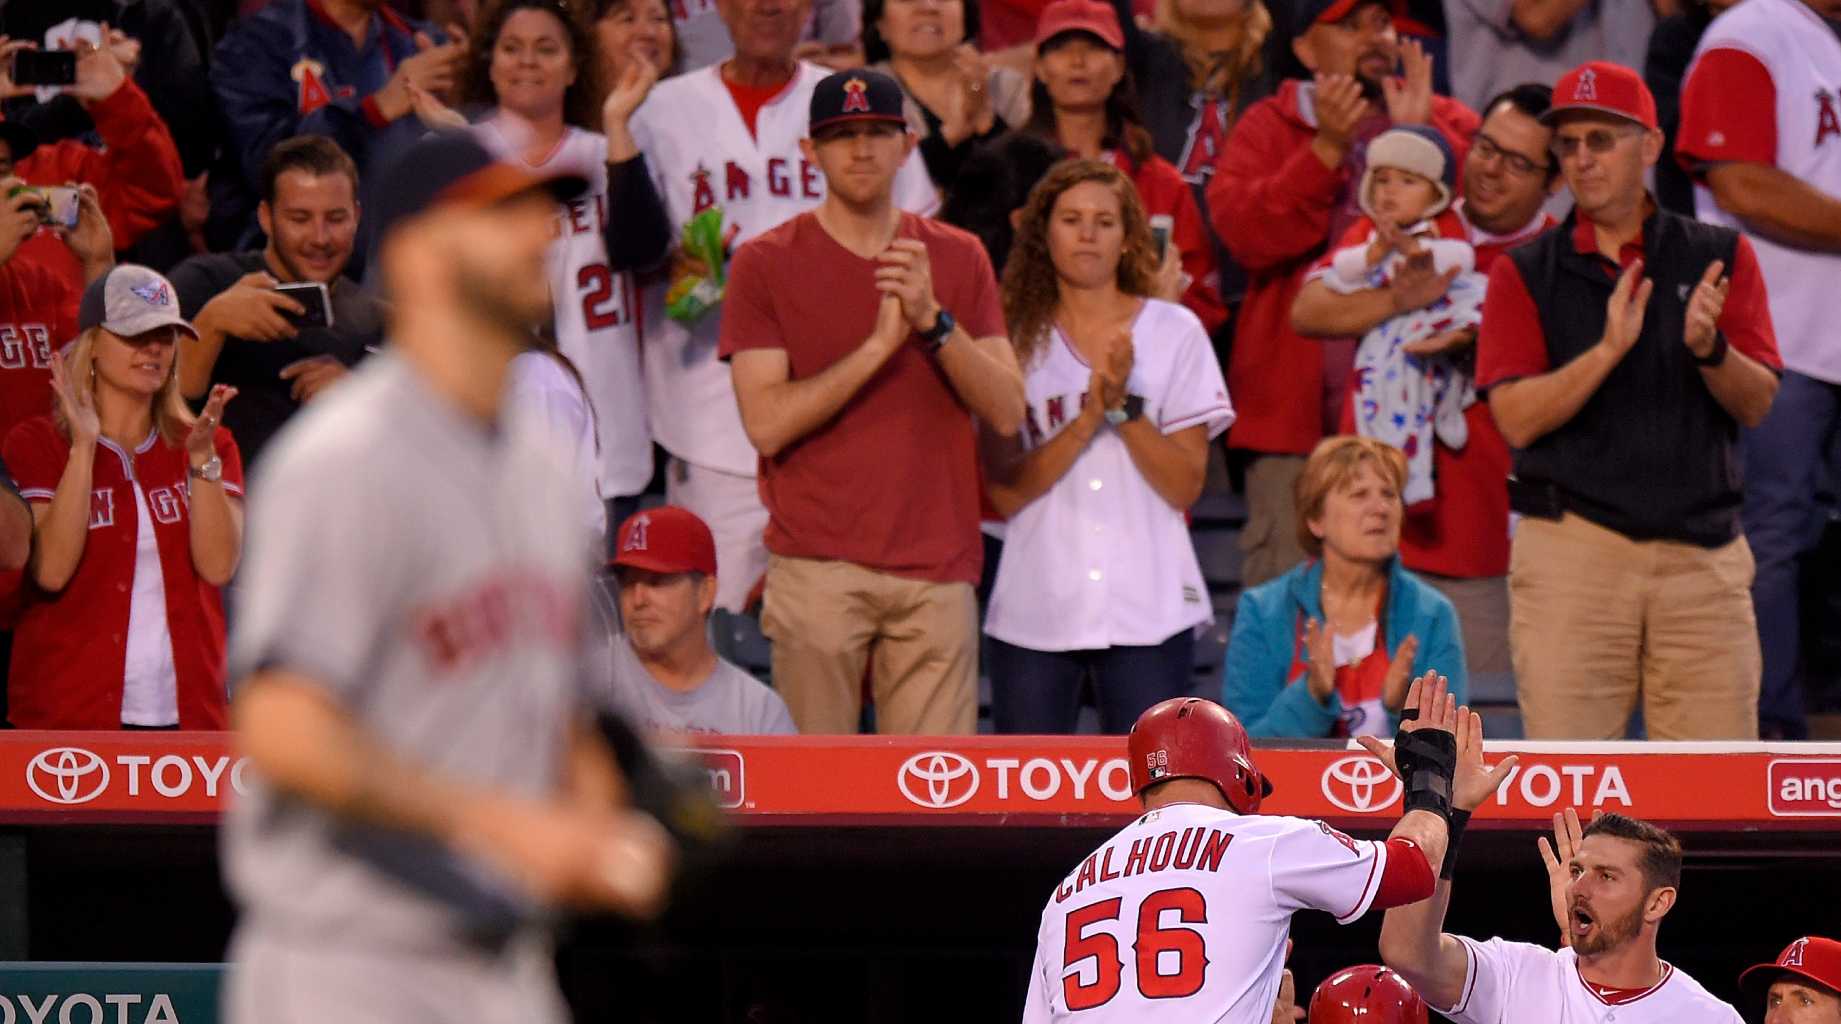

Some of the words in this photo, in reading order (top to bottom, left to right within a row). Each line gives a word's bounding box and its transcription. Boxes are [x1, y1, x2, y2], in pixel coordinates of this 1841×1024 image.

[1146, 749, 1168, 769] 56
[986, 758, 1132, 801] TOYO
[1780, 777, 1841, 809] ang
[1056, 826, 1234, 904] CALHOUN
[1062, 887, 1211, 1012] 56
[1780, 936, 1809, 967] A
